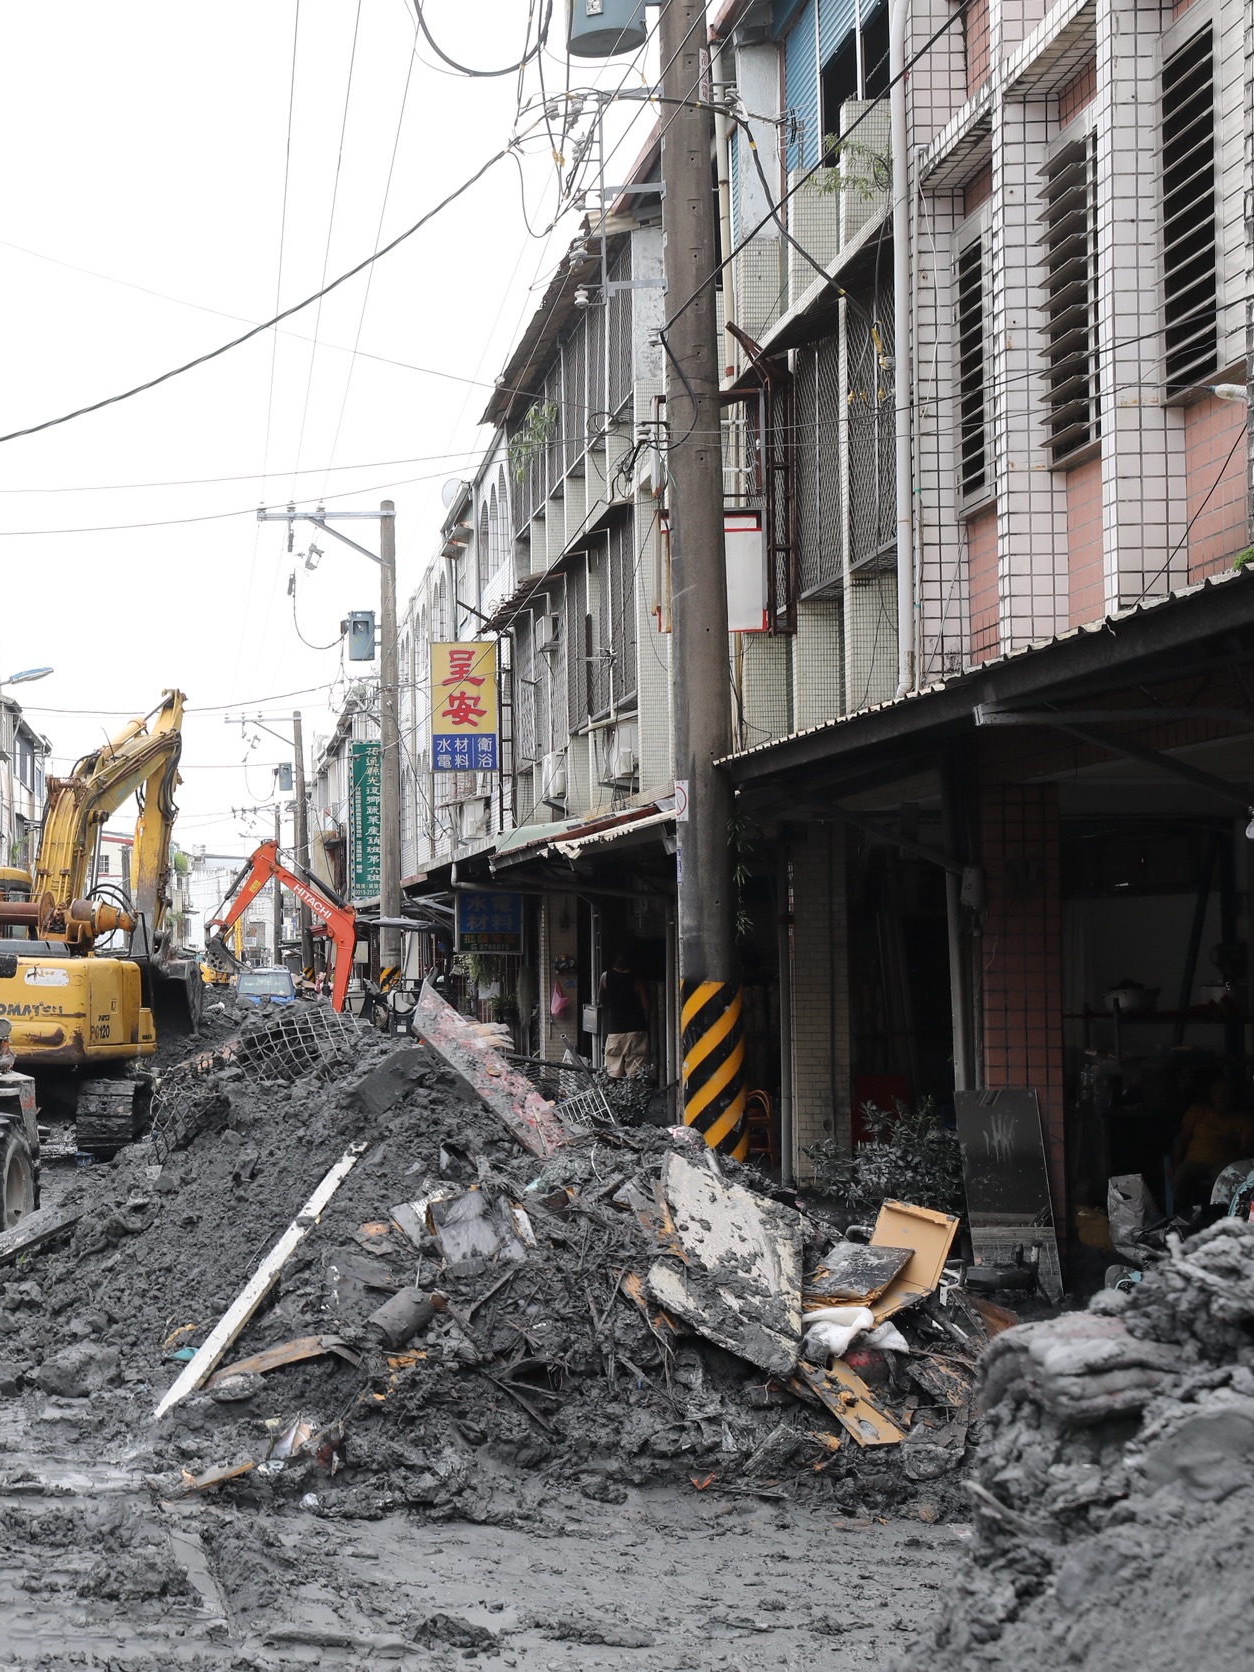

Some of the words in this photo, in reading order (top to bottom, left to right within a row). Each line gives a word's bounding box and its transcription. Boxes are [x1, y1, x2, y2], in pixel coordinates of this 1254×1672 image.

[442, 650, 487, 727] 呈安
[293, 884, 332, 919] HITACHI
[467, 914, 514, 930] 材料
